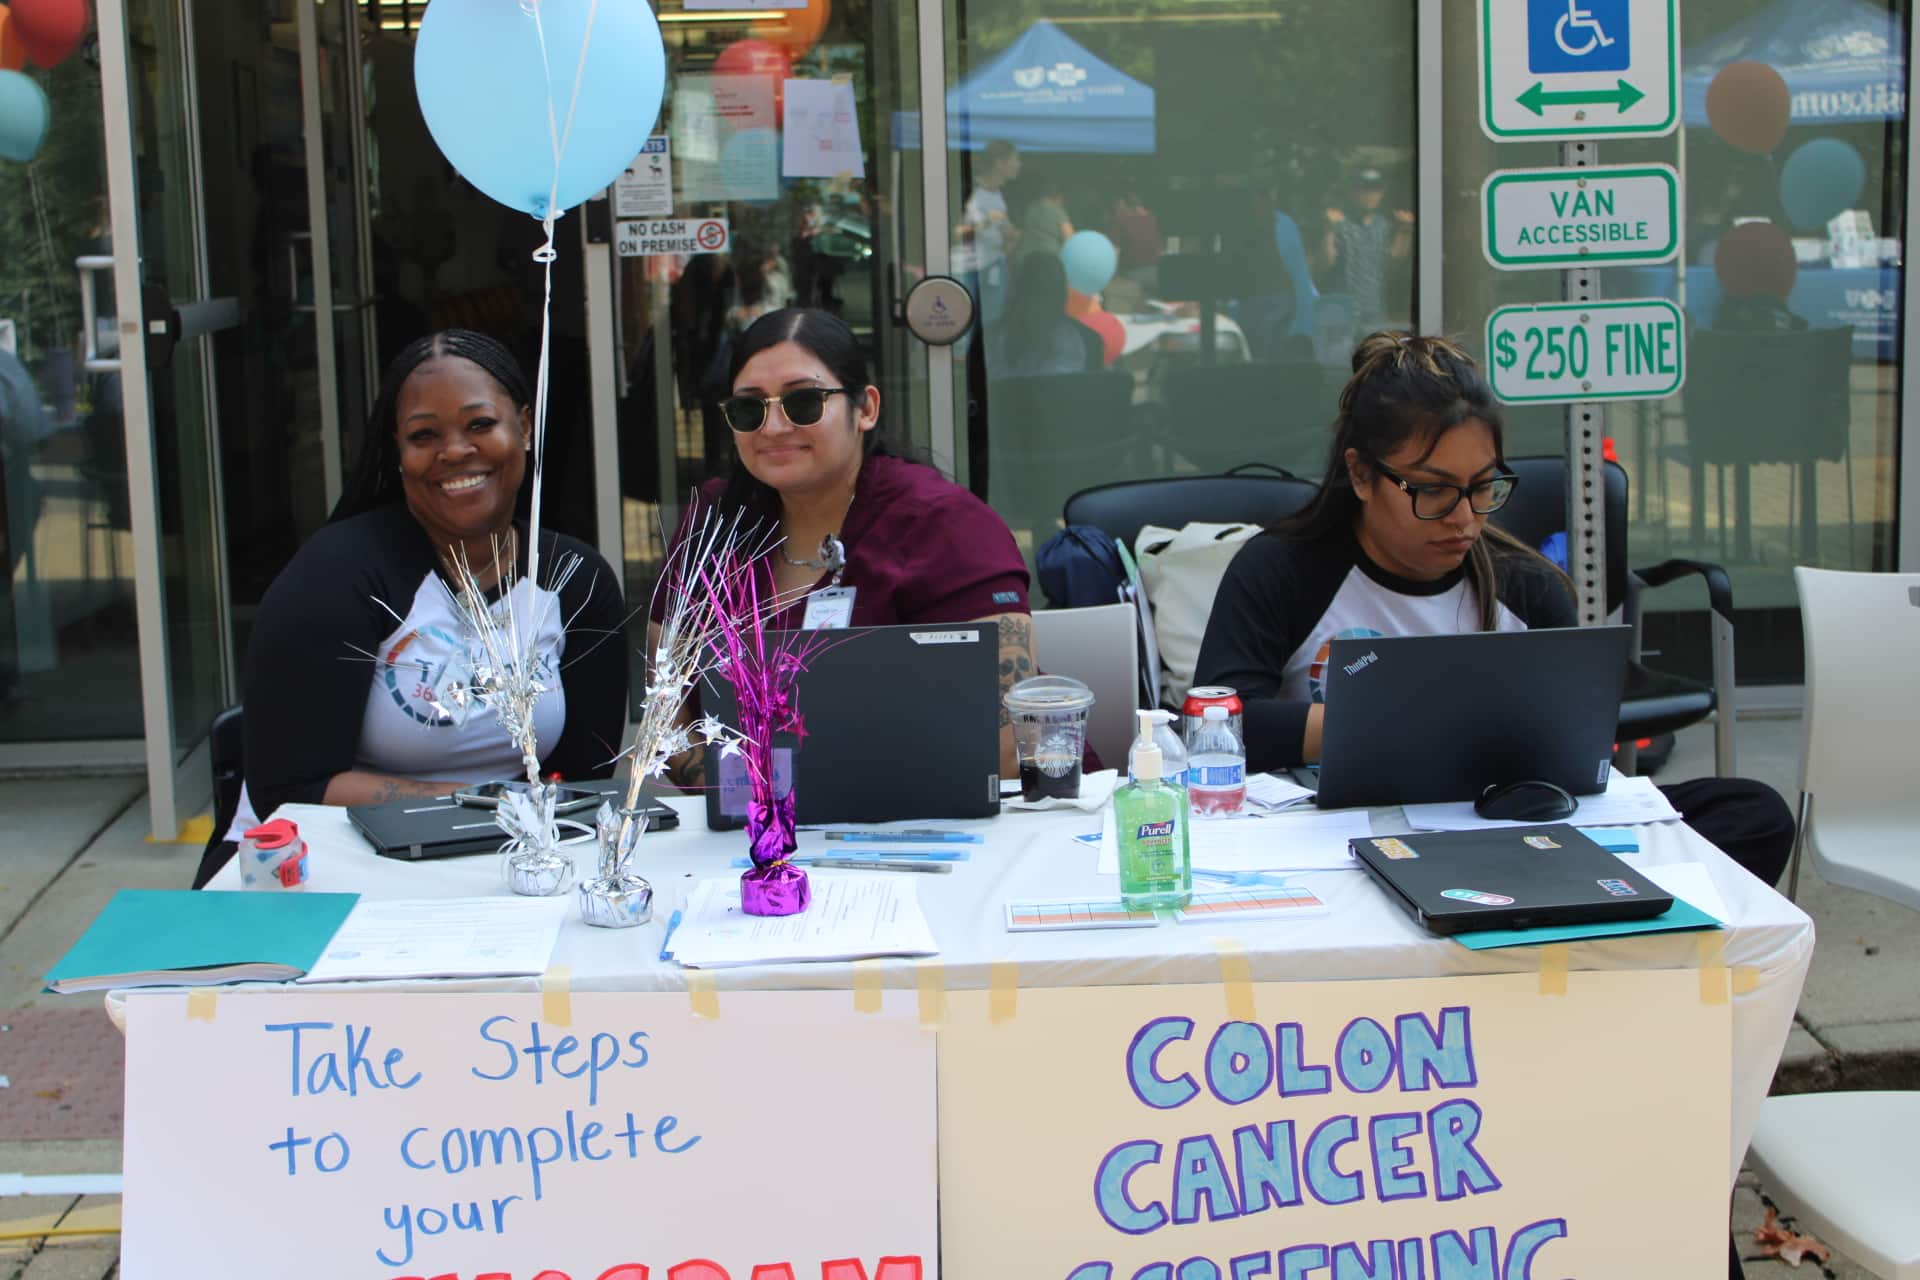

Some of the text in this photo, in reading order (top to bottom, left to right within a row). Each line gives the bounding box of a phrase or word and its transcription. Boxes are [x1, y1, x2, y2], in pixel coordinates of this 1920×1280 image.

[643, 141, 664, 151] ETS
[1550, 188, 1615, 218] VAN
[629, 222, 686, 236] NO CASH
[1518, 221, 1649, 245] ACCESSIBLE
[620, 239, 696, 254] ON PREMISE
[1495, 320, 1676, 380] $250 FINE
[1343, 650, 1378, 676] ThinkPad
[1141, 822, 1172, 836] Purell
[264, 1015, 649, 1105] Take Steps
[1126, 1005, 1478, 1110] COLON
[268, 1111, 701, 1201] to complete
[1094, 1099, 1502, 1234] CANCER
[375, 1195, 524, 1268] your
